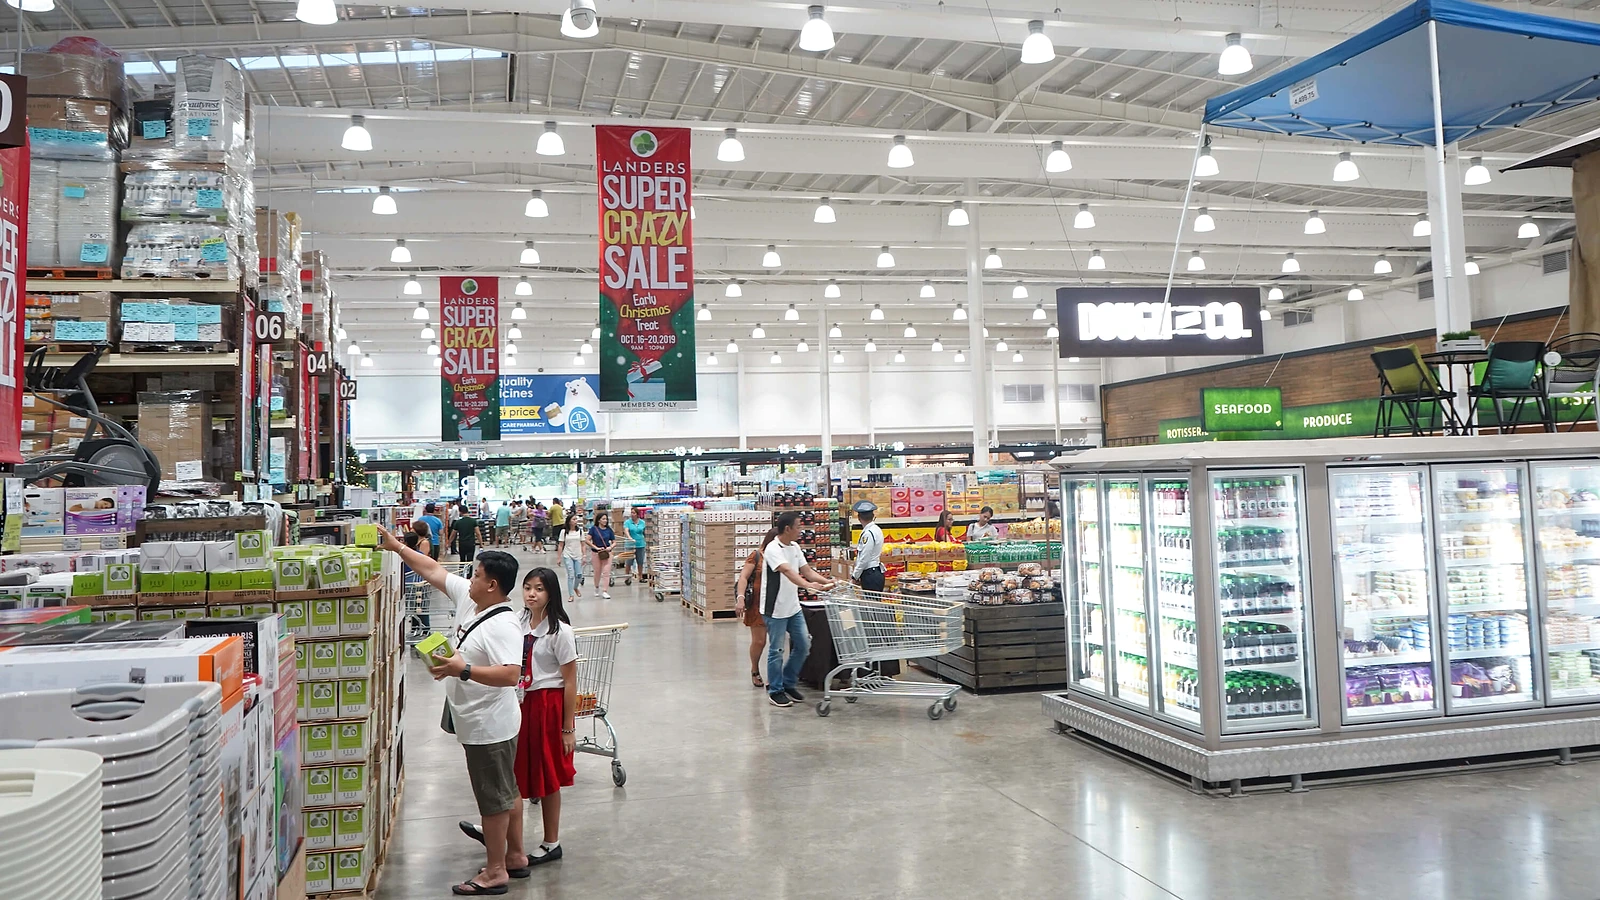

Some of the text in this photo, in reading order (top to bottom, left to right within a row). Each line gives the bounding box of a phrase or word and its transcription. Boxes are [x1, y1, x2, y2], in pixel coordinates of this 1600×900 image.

[603, 160, 686, 174] LANDERS
[603, 174, 688, 210] SUPER
[603, 210, 688, 246] CRAZY
[604, 245, 688, 290] SALE
[632, 292, 657, 306] Early
[444, 306, 496, 327] SUPER
[620, 304, 671, 318] Christmas
[255, 314, 282, 340] 06
[635, 318, 660, 331] Treat
[444, 327, 496, 348] CRAZY
[620, 335, 636, 344] OCT.
[307, 354, 327, 373] 04
[444, 348, 496, 375] SALE
[461, 376, 477, 385] Early
[340, 382, 356, 398] 02
[454, 384, 486, 392] Christmas
[463, 392, 478, 400] Treat
[509, 408, 536, 418] price
[1214, 404, 1272, 414] SEAFOOD
[1303, 412, 1352, 428] PRODUCE
[1166, 426, 1209, 439] ROTISSER
[1063, 438, 1074, 446] 21
[568, 448, 580, 459] 11
[586, 448, 597, 458] 12
